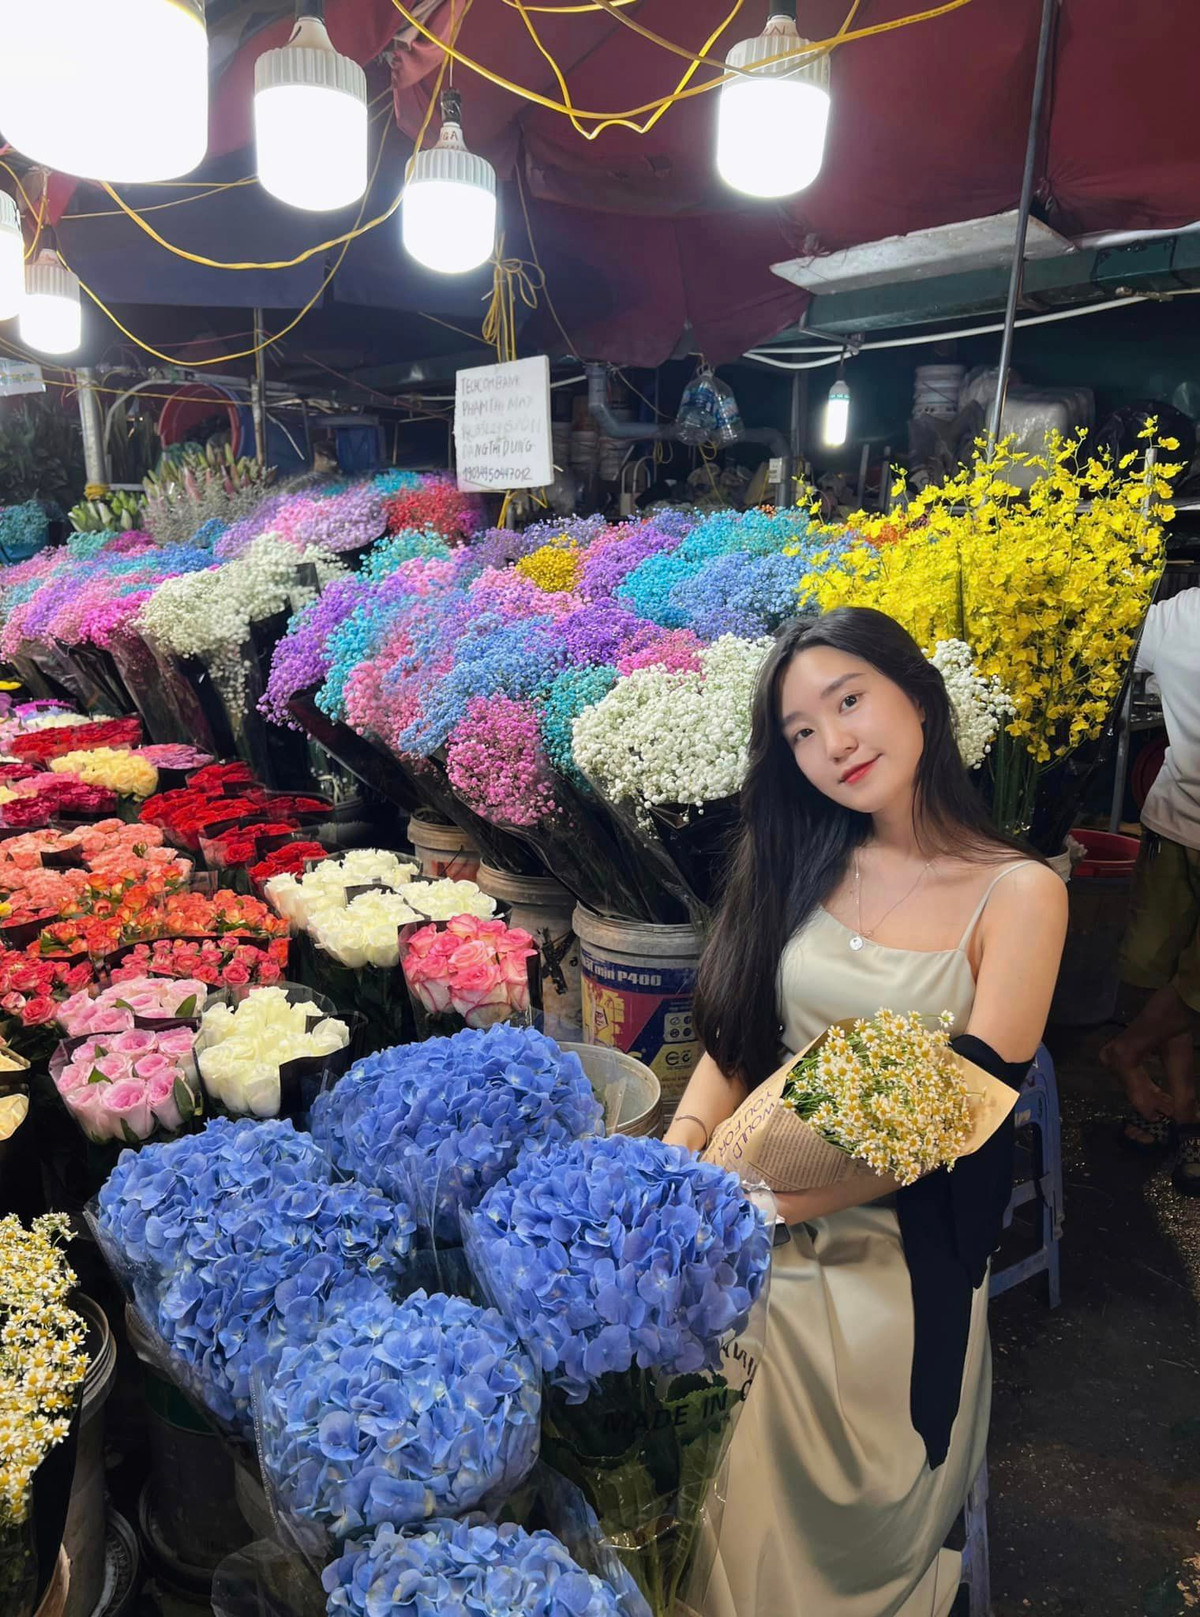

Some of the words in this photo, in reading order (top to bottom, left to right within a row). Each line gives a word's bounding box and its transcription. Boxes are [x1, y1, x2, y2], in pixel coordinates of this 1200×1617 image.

[617, 970, 662, 986] P400
[732, 1102, 775, 1160] WOULD
[604, 1404, 690, 1433] MADE
[702, 1387, 729, 1418] IN
